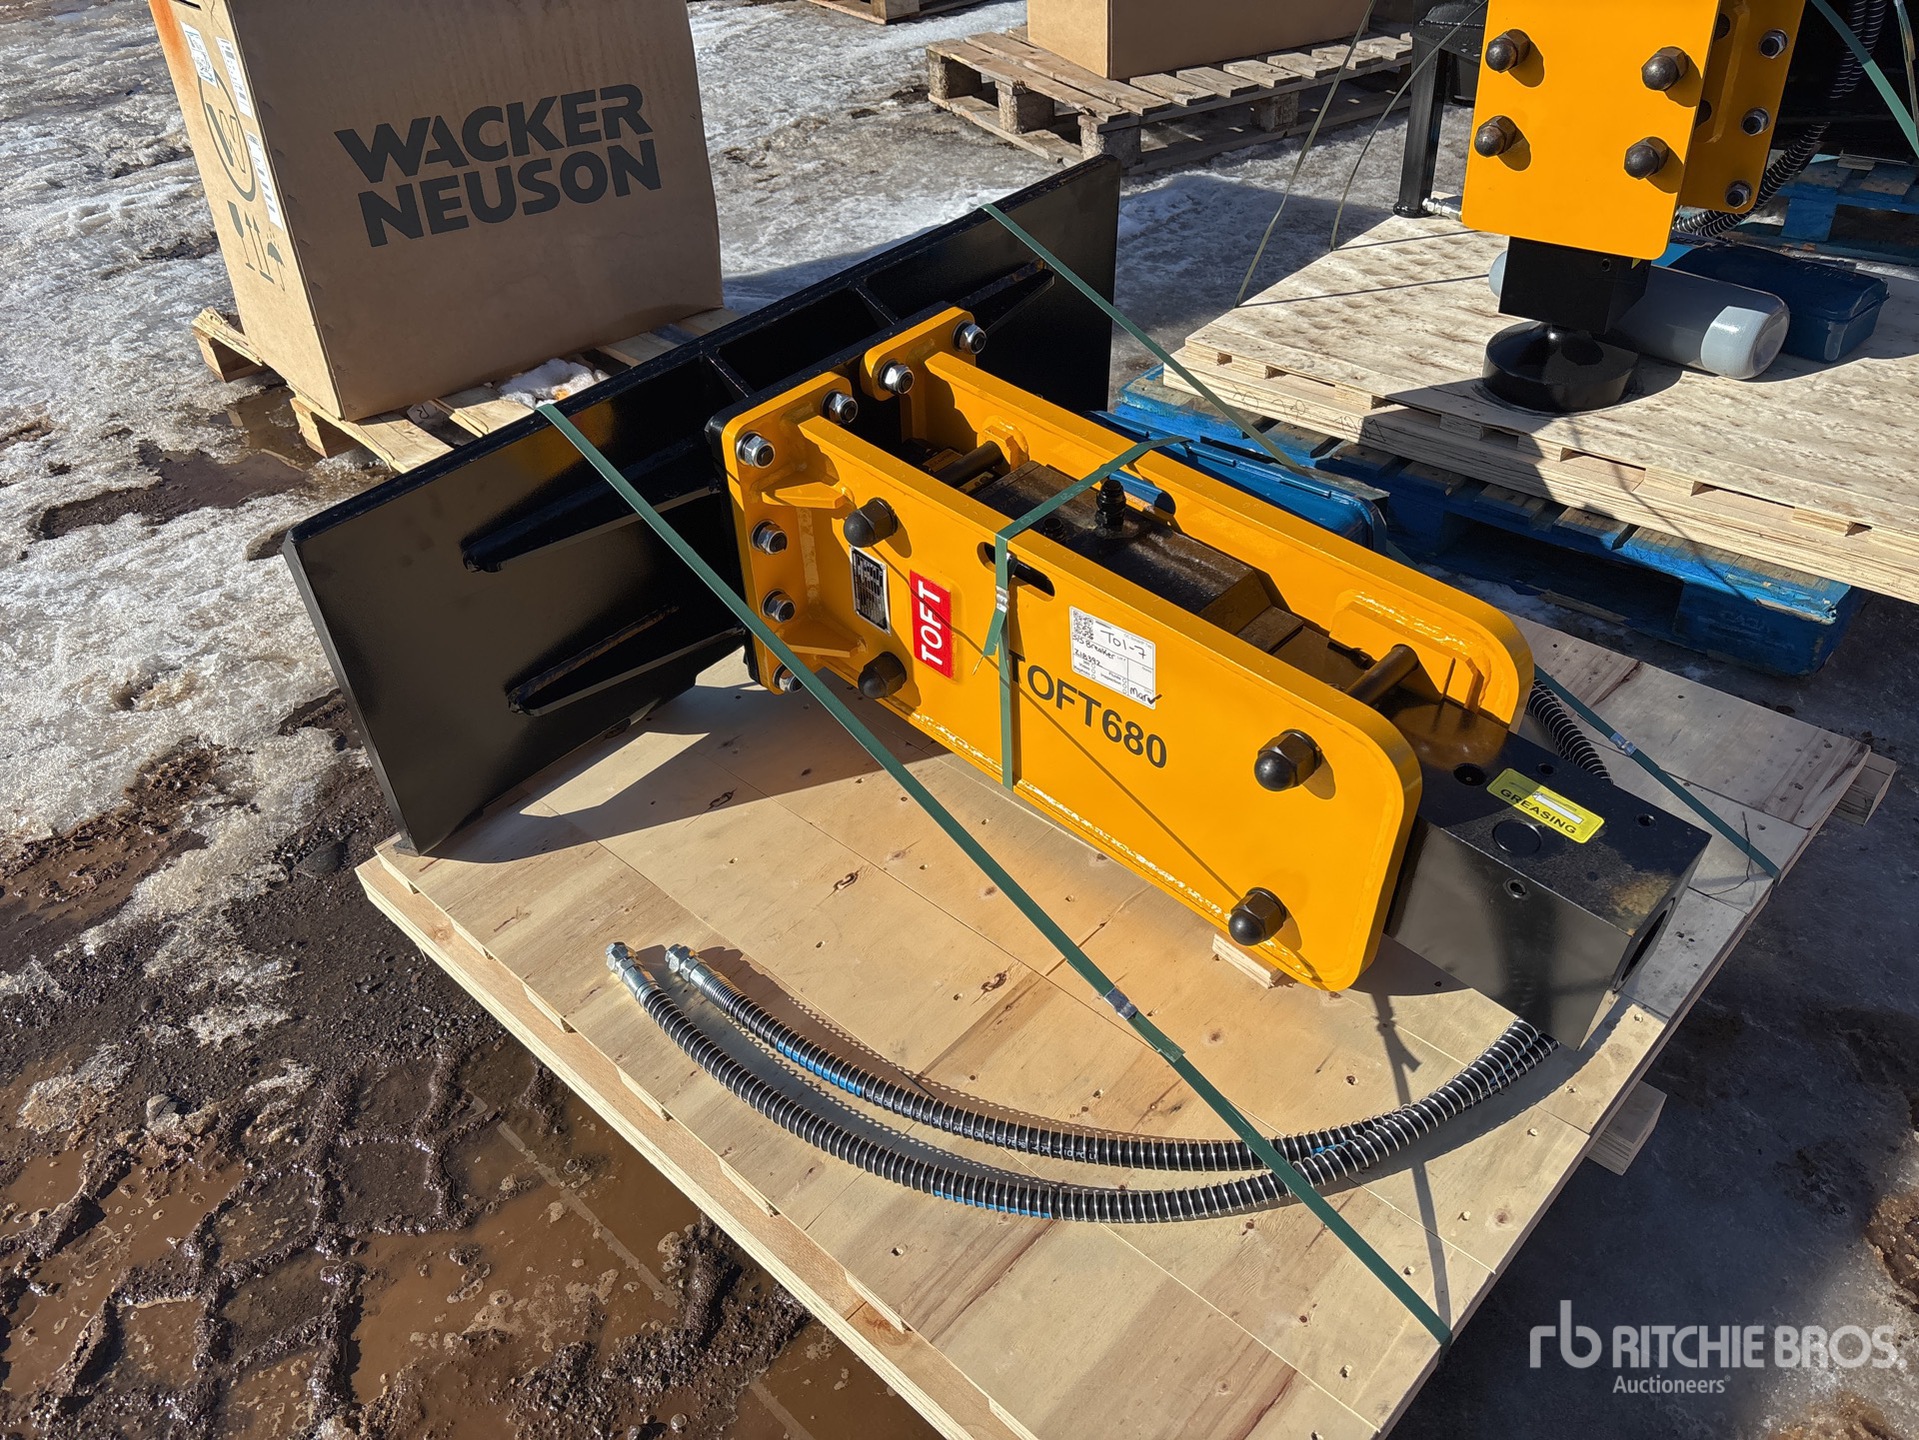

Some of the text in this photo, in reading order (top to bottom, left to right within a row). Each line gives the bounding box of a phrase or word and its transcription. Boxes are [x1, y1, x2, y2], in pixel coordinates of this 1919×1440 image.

[334, 83, 654, 183] WACKER
[357, 138, 662, 248] NEUSON
[917, 580, 943, 667] TOFT
[1009, 653, 1167, 768] TOFT680
[1500, 789, 1577, 834] GREASING
